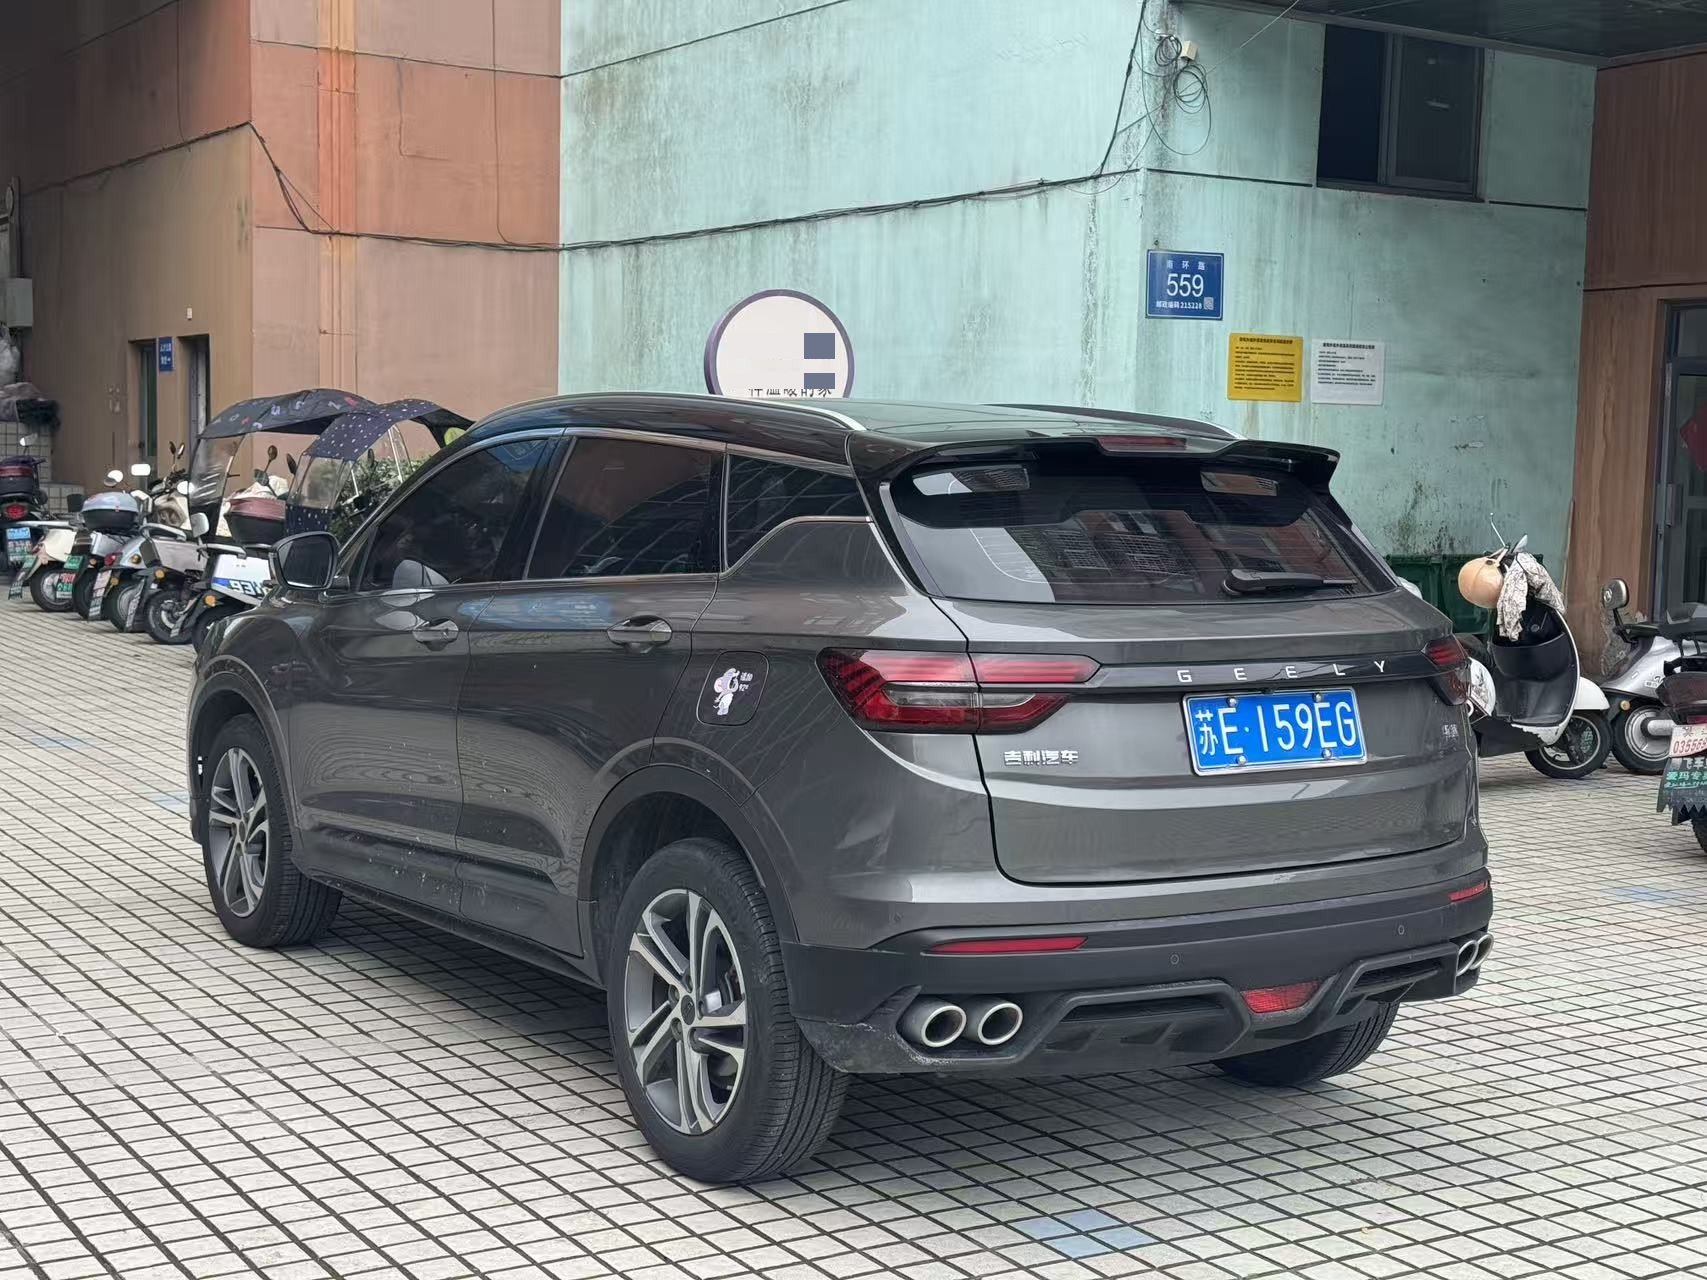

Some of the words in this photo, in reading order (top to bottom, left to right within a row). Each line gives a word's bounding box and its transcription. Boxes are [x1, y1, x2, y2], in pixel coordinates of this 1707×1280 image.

[1166, 273, 1204, 297] 559
[1176, 660, 1386, 683] GEELY
[1004, 750, 1079, 765] 吉利汽车
